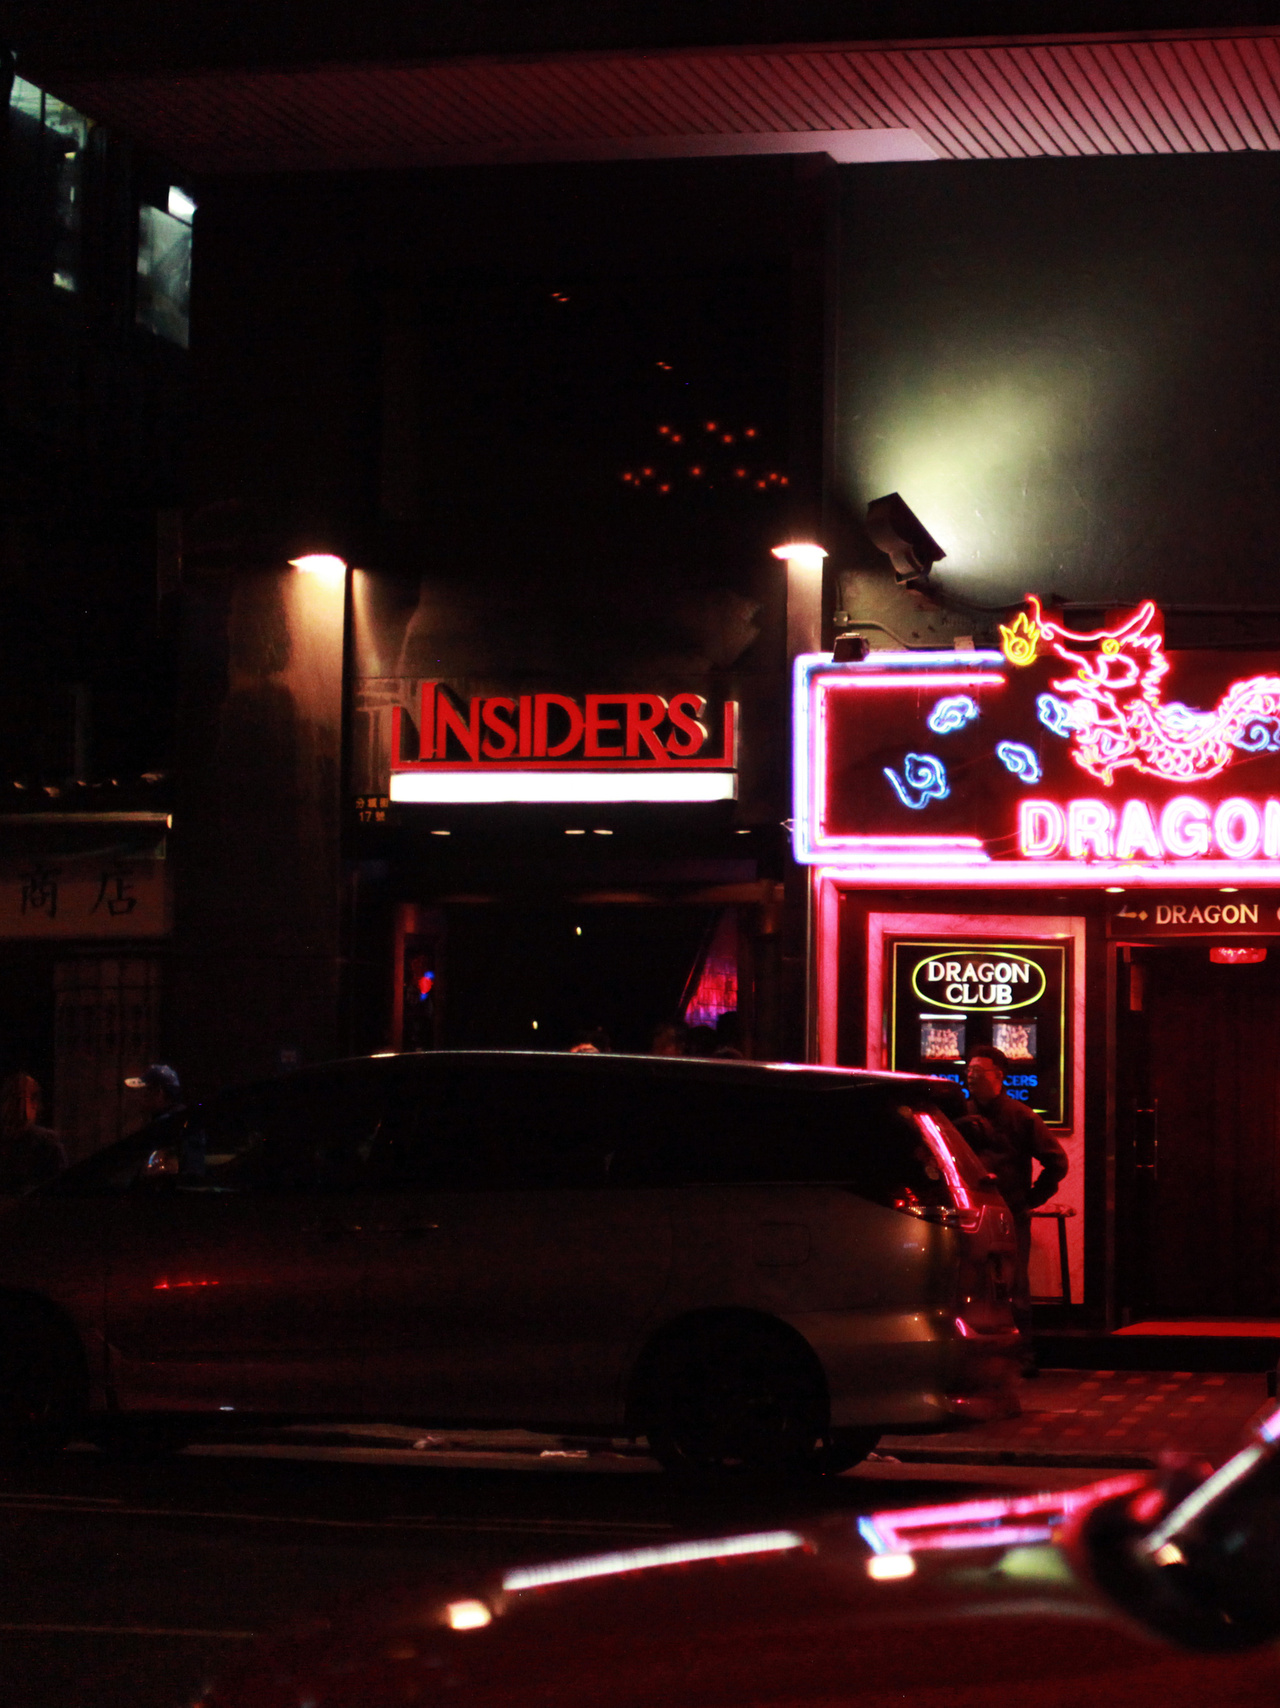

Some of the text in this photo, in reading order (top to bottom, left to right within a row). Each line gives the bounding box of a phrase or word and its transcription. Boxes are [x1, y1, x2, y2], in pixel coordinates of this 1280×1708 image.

[420, 682, 708, 763] INSIDERS
[1155, 903, 1260, 926] DRAGON
[927, 961, 1030, 984] DRAGON
[945, 983, 1013, 1005] CLUB
